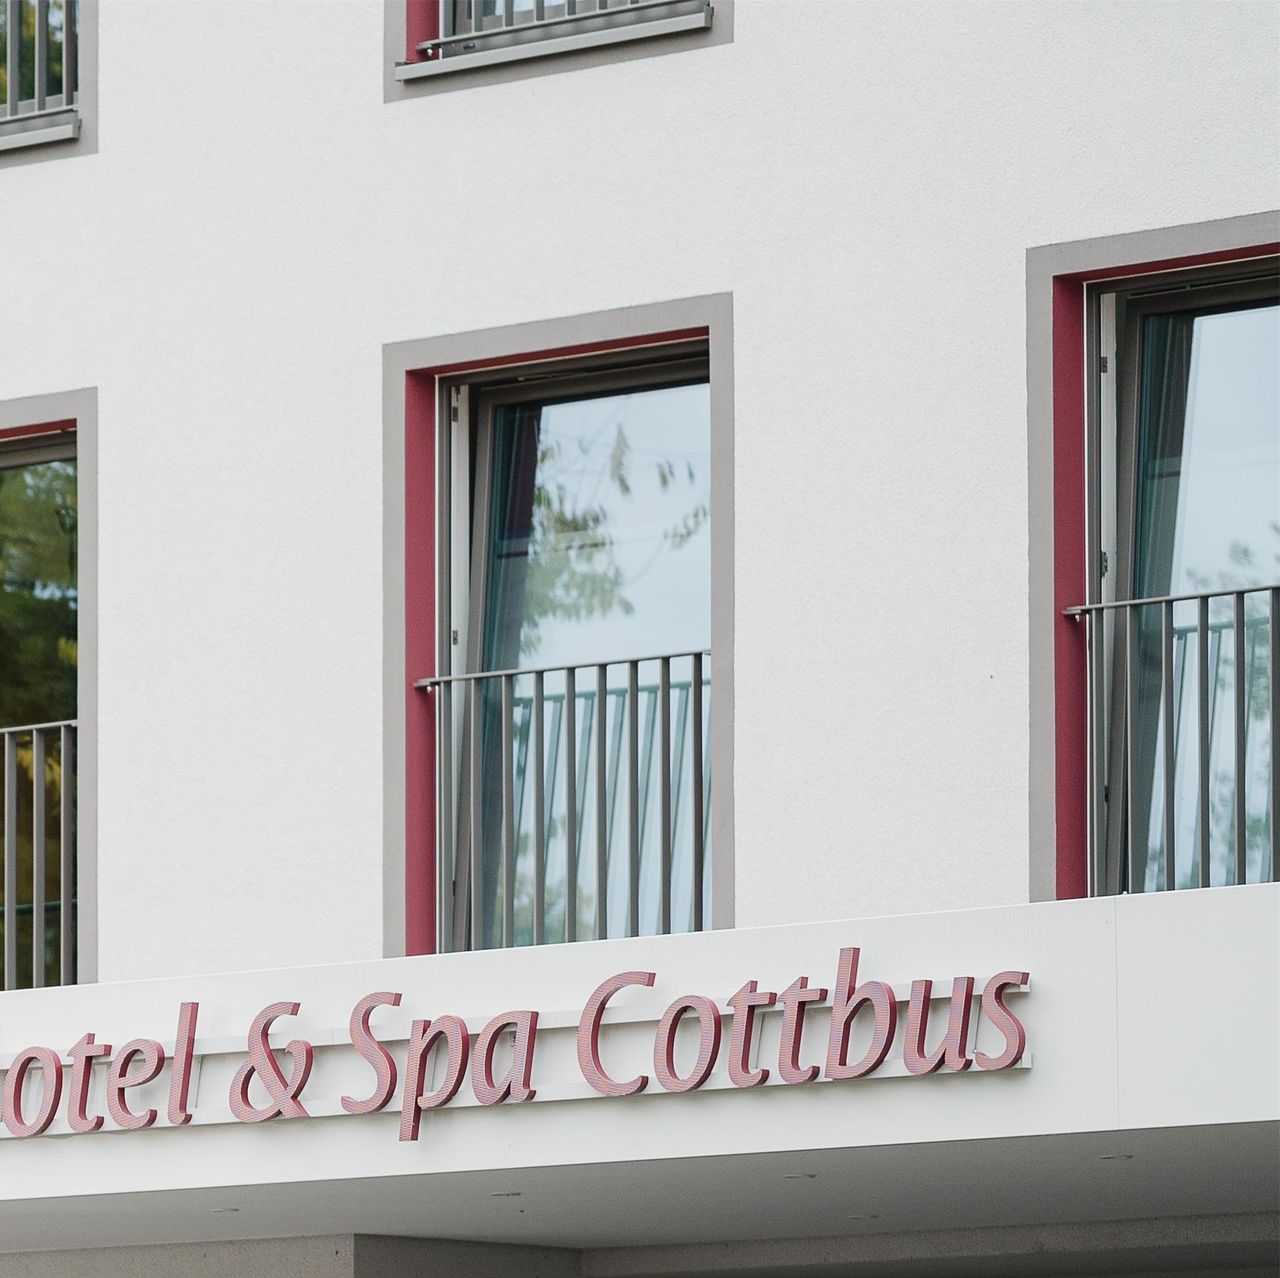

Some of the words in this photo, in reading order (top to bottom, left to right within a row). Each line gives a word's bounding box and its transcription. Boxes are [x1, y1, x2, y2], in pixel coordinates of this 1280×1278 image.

[228, 1001, 313, 1123] &
[341, 991, 539, 1142] Spa
[576, 946, 1030, 1097] Cottbus
